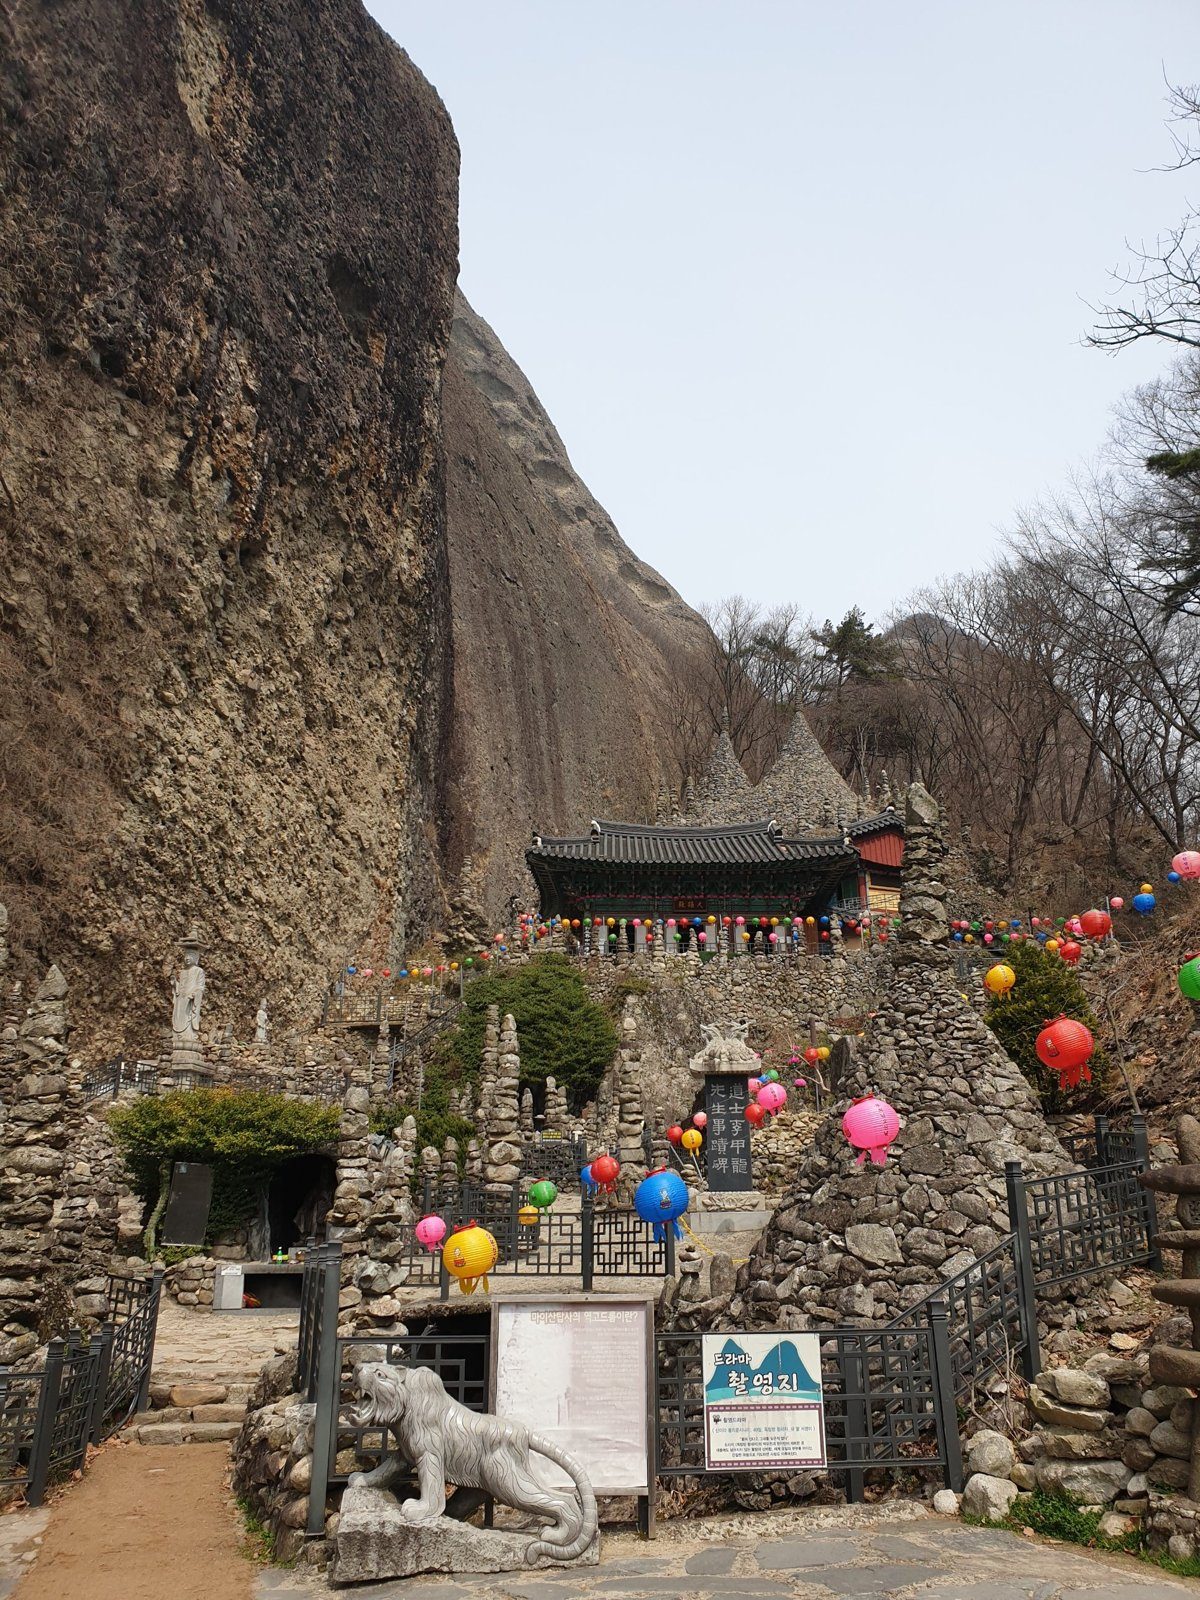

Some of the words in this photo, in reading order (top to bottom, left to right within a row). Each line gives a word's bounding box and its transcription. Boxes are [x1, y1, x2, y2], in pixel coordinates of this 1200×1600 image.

[531, 1311, 580, 1325] 마이산탑사의
[583, 1311, 638, 1323] 역고드름이란?
[714, 1353, 752, 1366] 드라마
[728, 1370, 798, 1396] 촬영지
